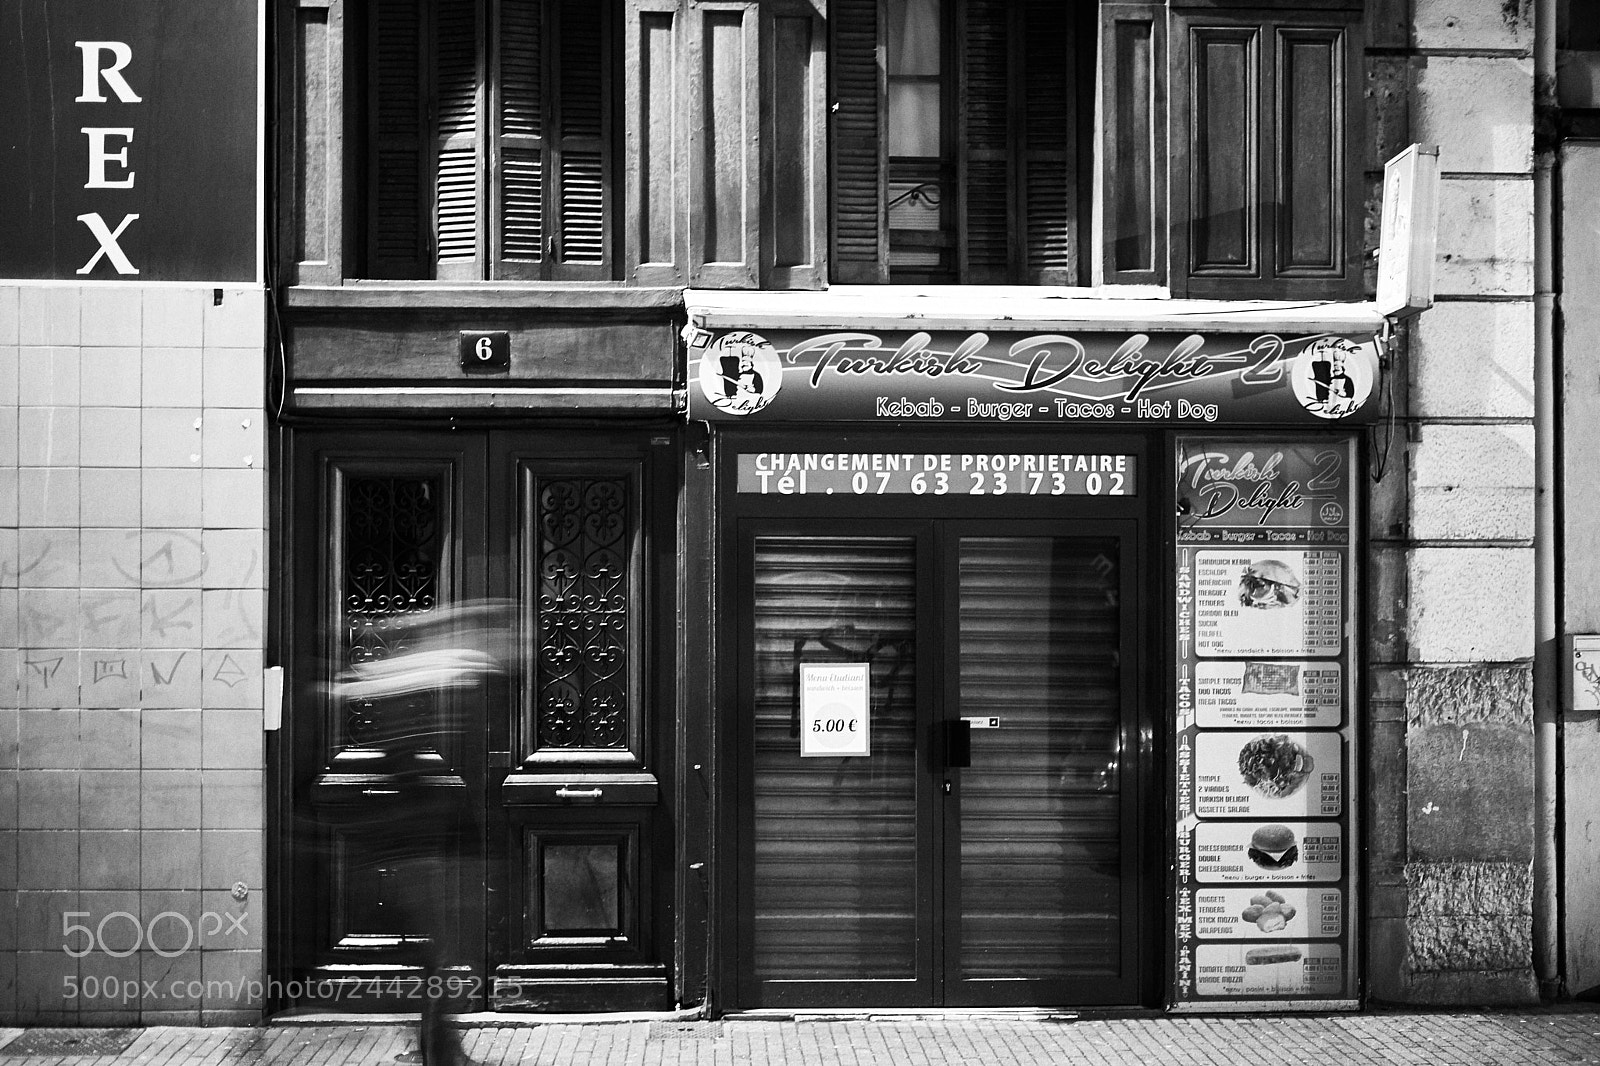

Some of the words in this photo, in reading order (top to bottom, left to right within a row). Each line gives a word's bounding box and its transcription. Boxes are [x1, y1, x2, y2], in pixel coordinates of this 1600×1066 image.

[74, 40, 142, 276] REX
[474, 336, 493, 360] 6
[787, 332, 989, 389] Turkish
[993, 334, 1247, 402] Delight
[1240, 334, 1285, 386] 2
[876, 397, 945, 417] Kebab
[967, 398, 1033, 420] Burger
[1055, 398, 1115, 419] Tacos
[1137, 399, 1172, 419] Hot
[1178, 400, 1219, 421] Dog
[755, 453, 915, 471] CHANGEMENT
[923, 454, 952, 471] DE
[961, 454, 1126, 472] PROPRIETAIRE
[1181, 451, 1284, 489] Turkish
[1307, 450, 1342, 490] 2
[851, 471, 891, 495] 07
[910, 472, 949, 495] 63
[969, 473, 1008, 495] 23
[1028, 473, 1067, 495] 73
[1085, 473, 1125, 496] 02
[1190, 481, 1337, 526] Delight
[1221, 530, 1256, 543] Burger
[1265, 530, 1297, 541] Tacos
[1307, 530, 1326, 541] Hot
[1327, 531, 1348, 543] Dog
[1178, 678, 1192, 715] TACOS
[812, 718, 845, 732] 5.00
[848, 718, 858, 732] €
[1178, 831, 1192, 876] BURGER
[1178, 949, 1191, 994] PANINI
